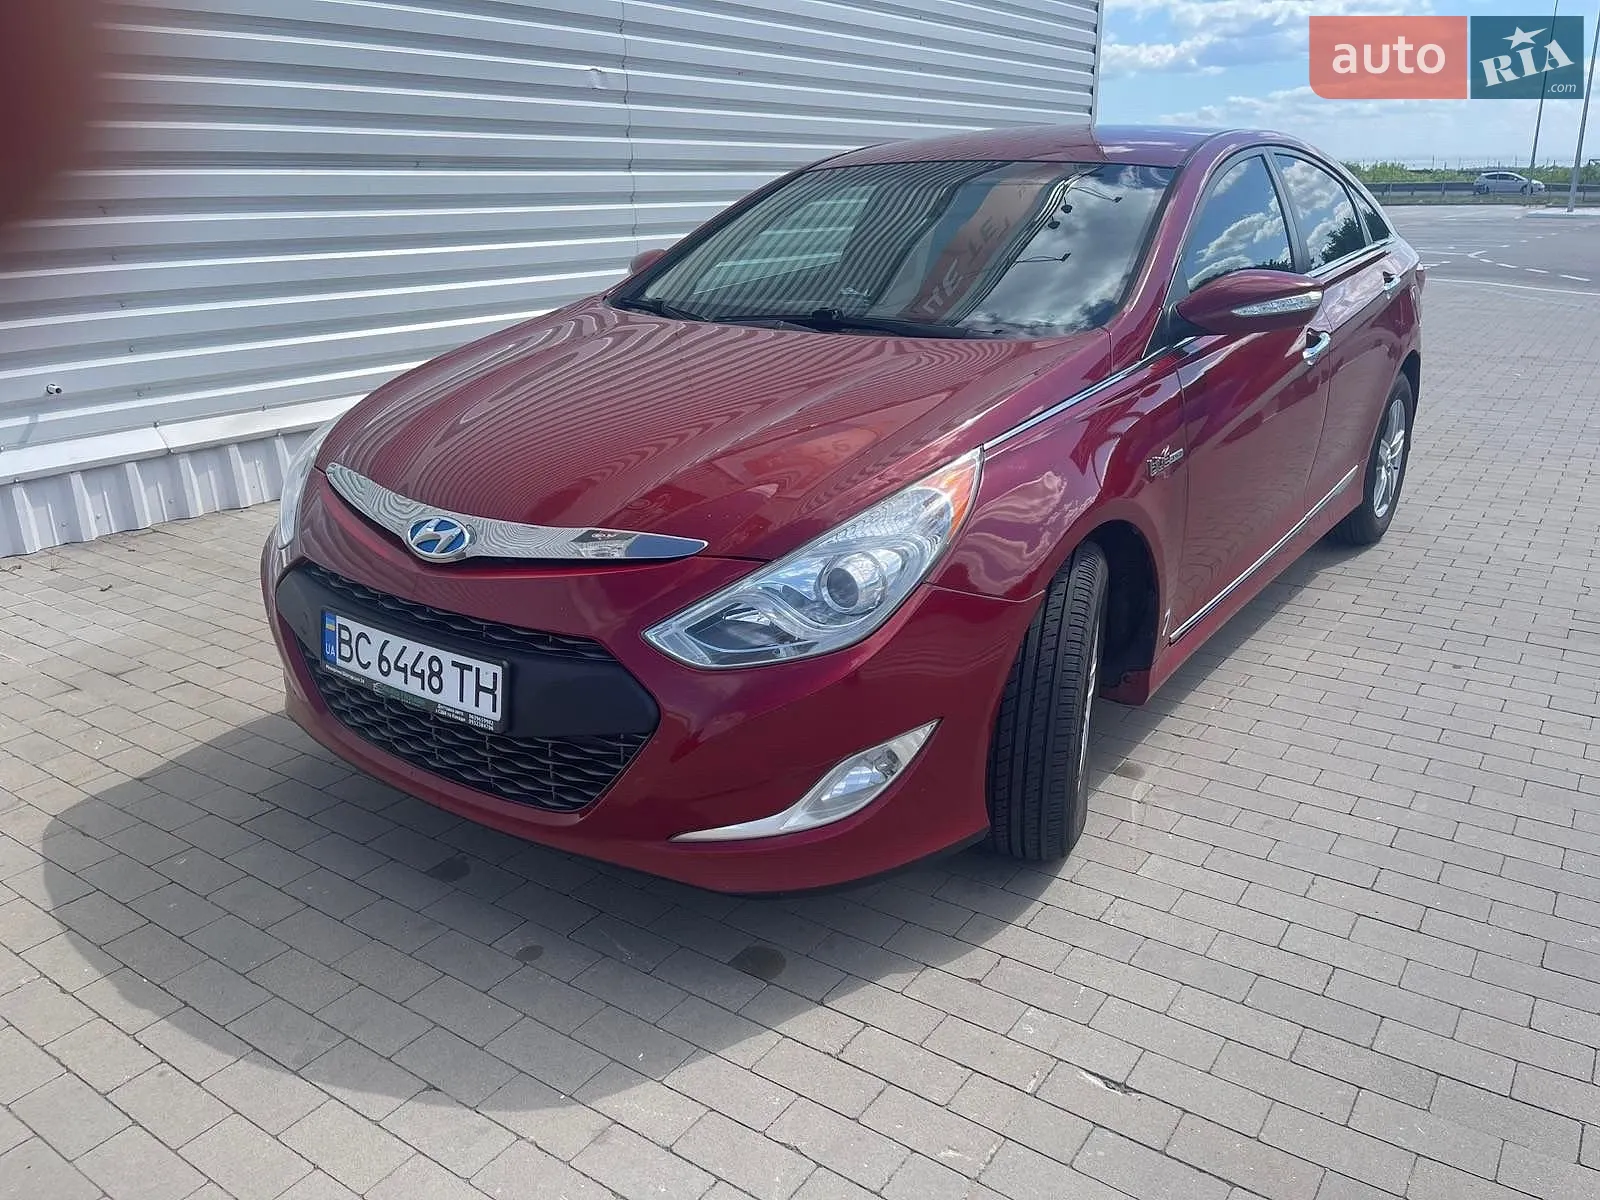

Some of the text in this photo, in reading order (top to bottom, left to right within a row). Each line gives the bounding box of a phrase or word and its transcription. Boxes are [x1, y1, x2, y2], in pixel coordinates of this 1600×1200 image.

[325, 642, 336, 657] UA
[338, 623, 372, 669] BC
[378, 640, 443, 695] 6448
[451, 660, 498, 713] TH
